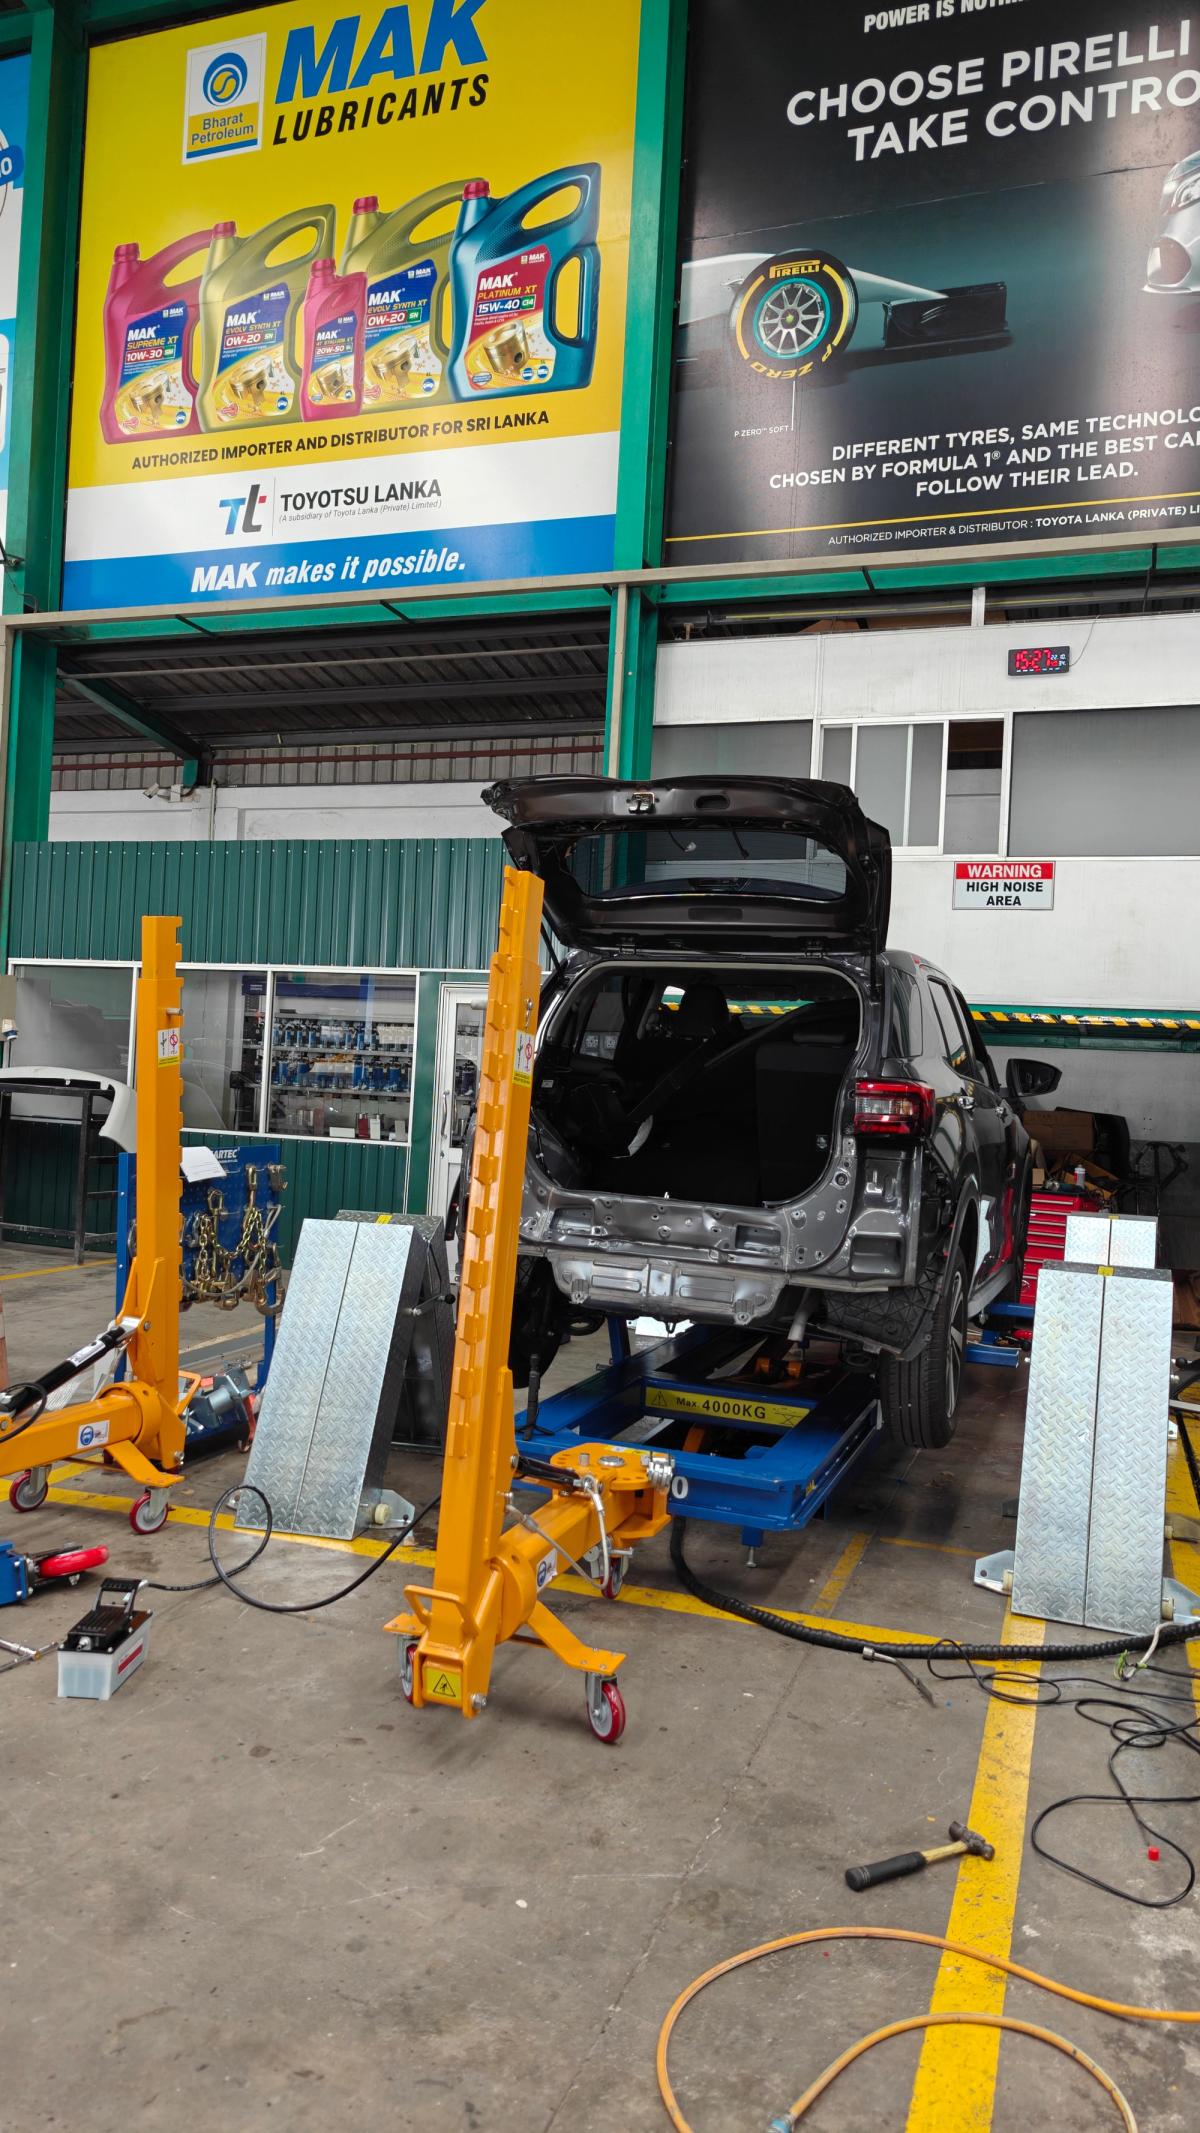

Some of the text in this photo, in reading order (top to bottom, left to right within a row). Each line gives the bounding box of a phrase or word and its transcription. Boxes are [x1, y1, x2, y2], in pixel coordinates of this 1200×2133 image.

[864, 3, 930, 33] POWER
[936, 0, 955, 18] IS
[275, 0, 488, 104] MAK
[786, 19, 1191, 126] CHOOSE PIRELLI
[272, 73, 489, 146] LUBRICANTS
[202, 111, 244, 131] Bharat
[191, 123, 255, 146] Petroleum
[847, 108, 969, 162] TAKE
[768, 259, 821, 279] PIRELLI
[477, 284, 538, 300] PLATINUM XT
[479, 273, 515, 291] MAK
[368, 289, 402, 306] MAK
[393, 301, 417, 310] SYNTH
[417, 298, 428, 307] XT
[478, 299, 520, 314] 15W-40
[226, 311, 258, 327] MAK
[127, 326, 158, 342] MAK
[127, 335, 179, 350] SUPREME XT
[316, 330, 338, 341] MAK
[127, 349, 163, 361] 10W-30
[131, 410, 550, 470] AUTHORIZED IMPORTER AND DISTRIBUTOR FOR SRI LANKA
[734, 430, 740, 438] P
[768, 425, 789, 434] SOFT
[832, 434, 940, 461] DIFFERENT
[945, 426, 1015, 449] TYRES,
[1021, 419, 1080, 440] SAME
[769, 467, 846, 489] CHOSEN
[852, 464, 877, 481] BY
[882, 454, 978, 478] FORMULA
[1006, 446, 1051, 466] AND
[1058, 441, 1098, 460] THE
[1104, 435, 1158, 455] BEST
[1164, 430, 1200, 449] CA
[916, 461, 1139, 497] FOLLOW THEIR LEAD.
[280, 479, 442, 512] TOYOTSU LANKA
[288, 512, 323, 523] subsidiary
[324, 510, 332, 519] of
[333, 507, 356, 518] Toyota
[358, 505, 379, 515] Lanka
[828, 531, 893, 546] AUTHORIZED
[895, 526, 947, 540] IMPORTER
[949, 525, 957, 535] &
[959, 520, 1028, 534] DISTRIBUTOR
[1036, 514, 1083, 527] TOYOTA
[1086, 511, 1125, 523] LANKA
[1128, 505, 1187, 521] (PRIVATE)
[191, 547, 466, 593] MAK makes it possible.
[967, 864, 1042, 879] WARNING
[966, 881, 1044, 893] HIGH NOISE
[986, 895, 1022, 907] AREA
[702, 1399, 767, 1420] 4000KG
